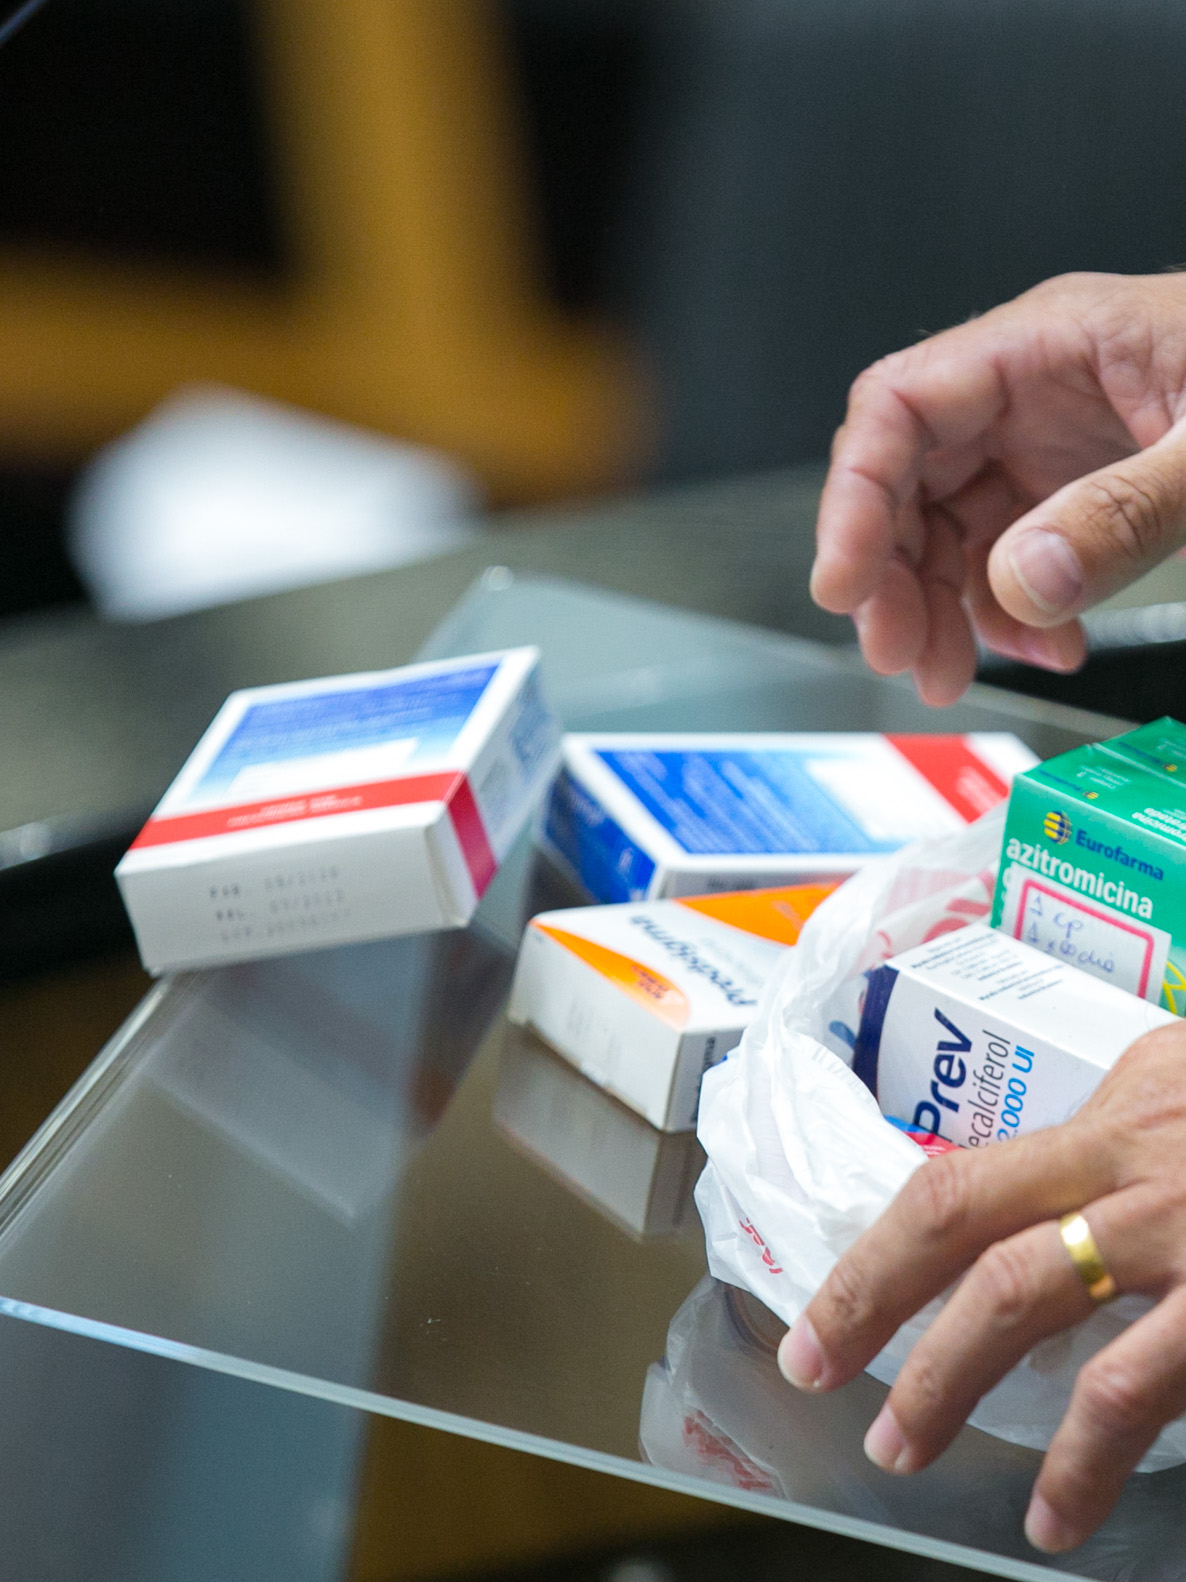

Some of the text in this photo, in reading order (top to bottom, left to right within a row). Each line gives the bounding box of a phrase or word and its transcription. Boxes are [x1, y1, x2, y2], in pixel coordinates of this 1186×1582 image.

[1005, 837, 1155, 920] azitromicina
[1075, 828, 1166, 881] Eurofarma
[957, 1028, 1011, 1151] ecalciferol
[1011, 1044, 1035, 1074] UI
